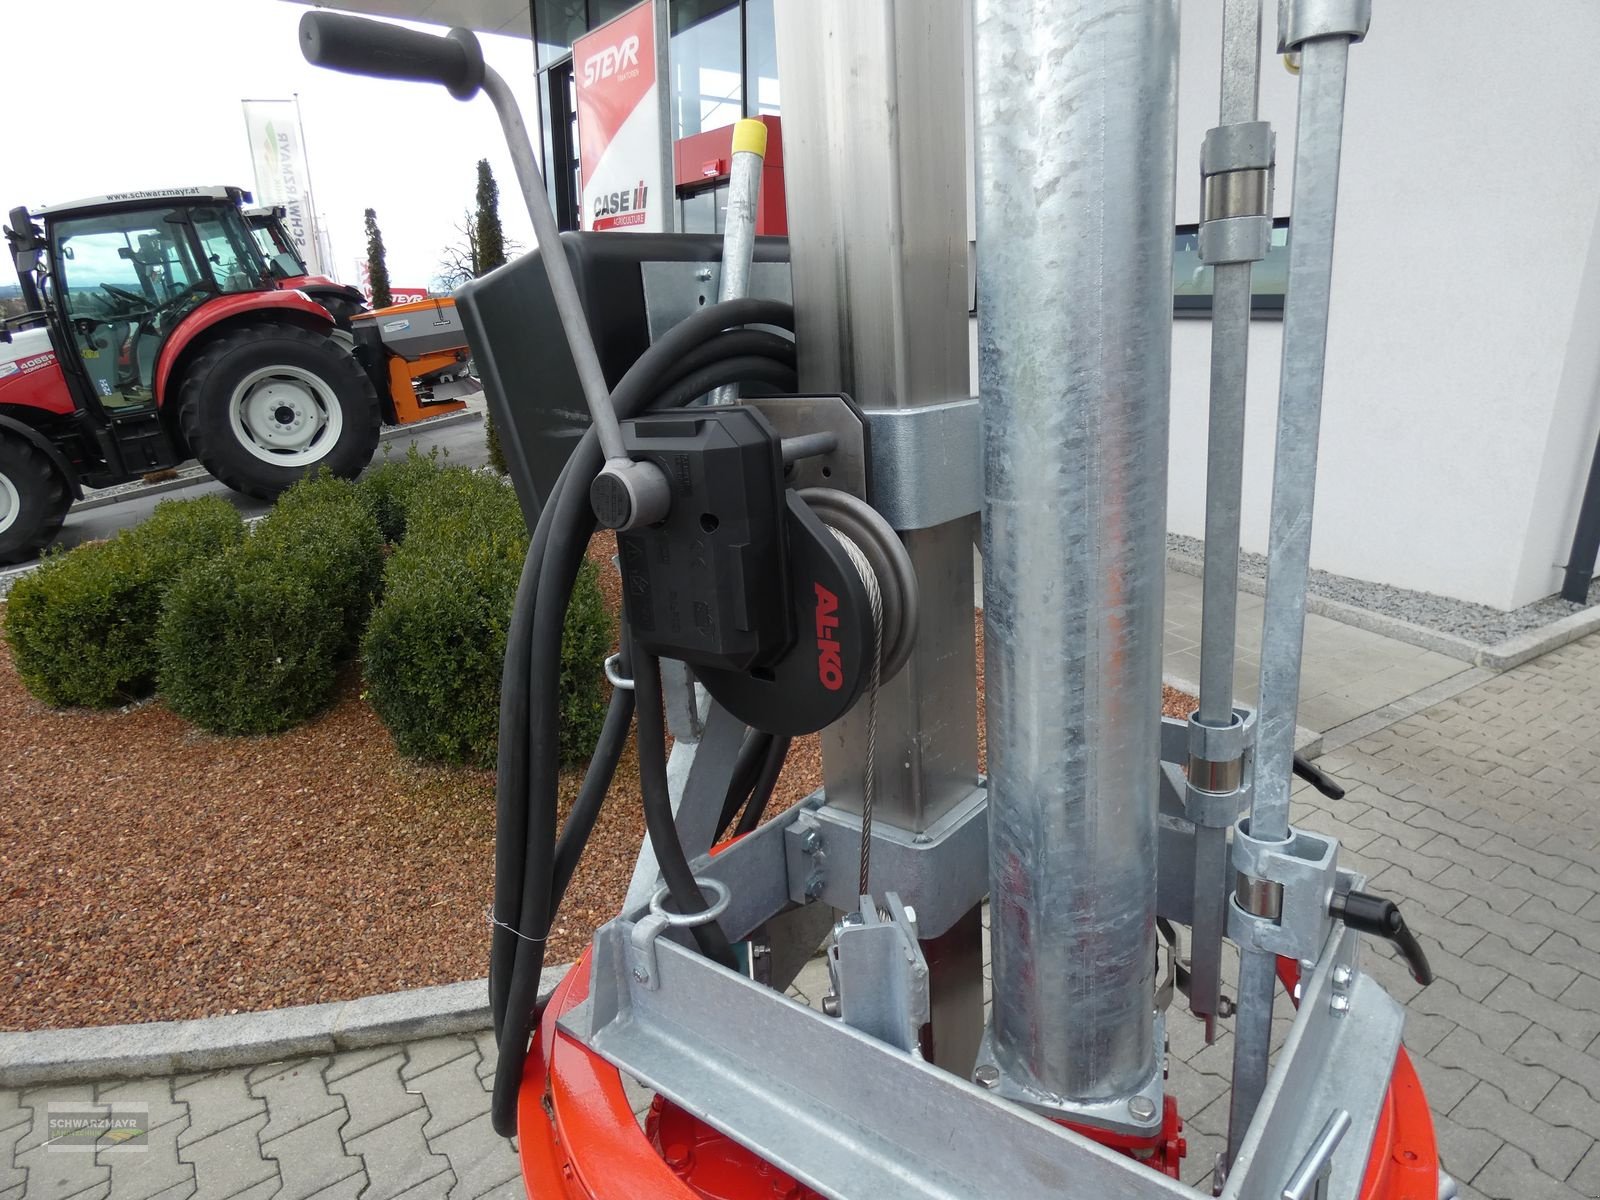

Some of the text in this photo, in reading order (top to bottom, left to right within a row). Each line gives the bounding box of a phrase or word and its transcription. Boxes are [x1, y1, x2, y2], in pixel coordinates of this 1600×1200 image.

[584, 36, 640, 88] STEYR
[106, 186, 200, 201] www.schwarzmayr.at
[595, 190, 630, 217] CASE
[814, 582, 845, 692] AL-KO
